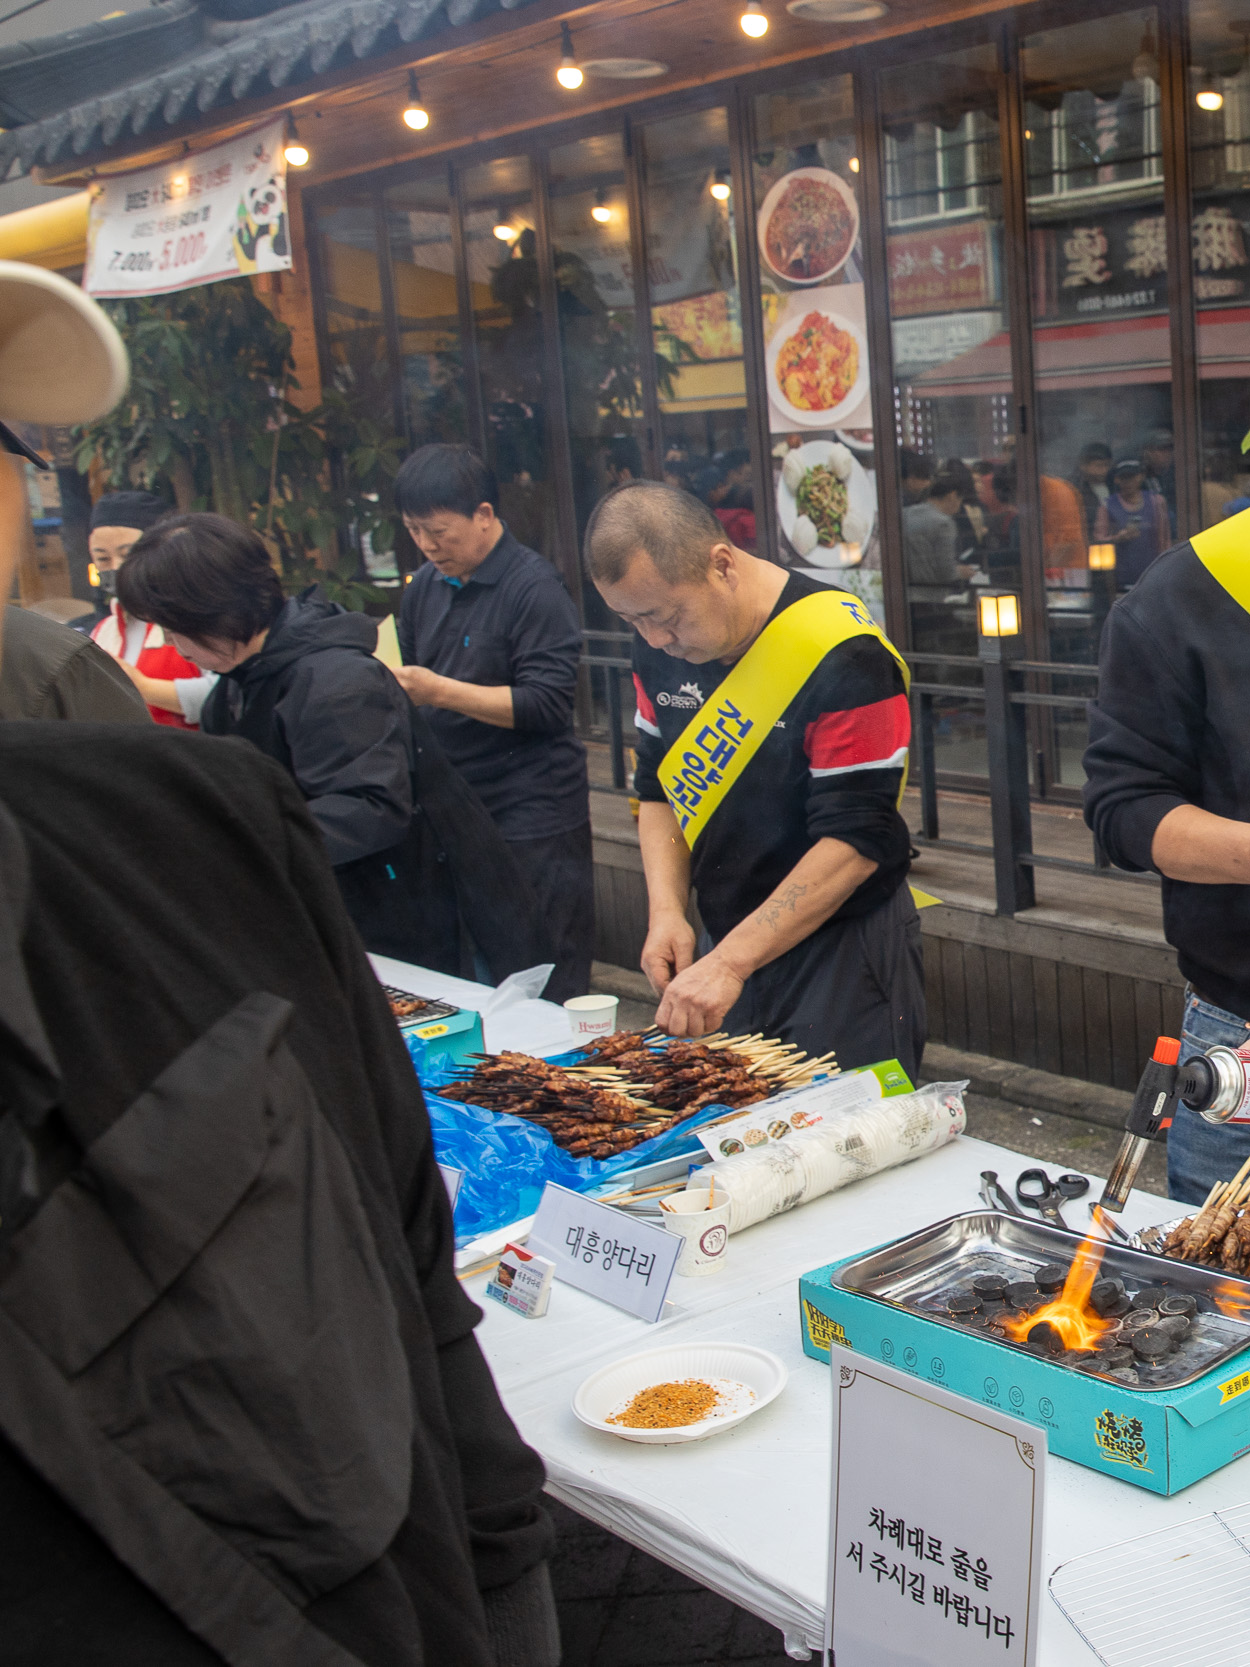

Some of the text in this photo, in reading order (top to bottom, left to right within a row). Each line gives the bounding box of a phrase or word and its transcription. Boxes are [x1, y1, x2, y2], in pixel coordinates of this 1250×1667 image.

[565, 1226, 657, 1287] 대흥양다리
[867, 1506, 993, 1592] 차례대로 줄을
[846, 1541, 1015, 1650] 서 주시길 바랍니다
